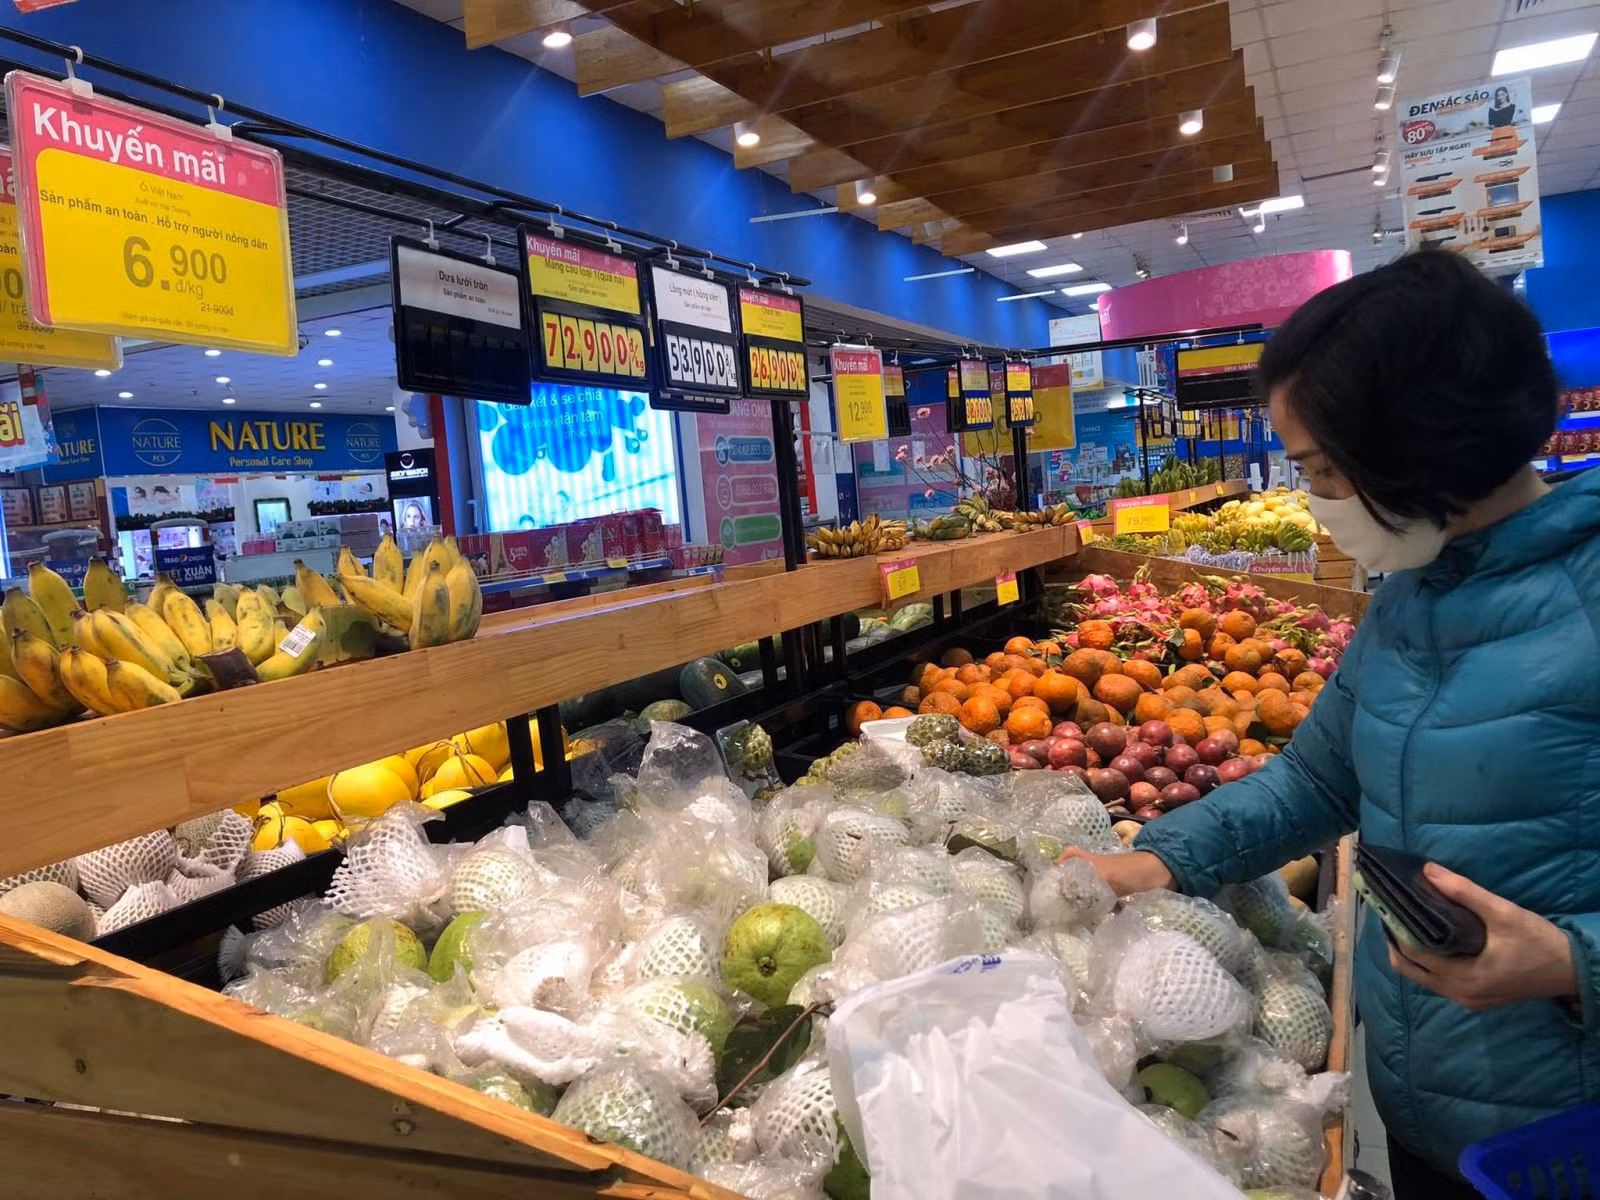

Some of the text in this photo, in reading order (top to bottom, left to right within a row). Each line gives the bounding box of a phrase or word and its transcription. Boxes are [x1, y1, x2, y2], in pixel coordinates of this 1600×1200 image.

[33, 102, 226, 185] Khuyến mãi
[40, 189, 65, 205] Sản
[68, 198, 102, 214] phẩm
[105, 207, 120, 217] an
[122, 208, 148, 223] toàn
[156, 214, 171, 229] Hỗ
[173, 220, 189, 233] trợ
[192, 226, 223, 240] người
[225, 232, 249, 249] nông
[250, 238, 268, 250] dân
[526, 237, 580, 262] Khuyến mãi
[123, 235, 227, 291] 6.900
[175, 278, 204, 300] đ/kg
[438, 270, 489, 291] Dưa lưới tròn
[546, 322, 627, 365] 72.900
[670, 342, 725, 377] 53.900
[751, 351, 797, 381] 26.900
[56, 438, 96, 458] ATURE
[132, 437, 182, 449] NATURE
[208, 419, 326, 452] NATURE
[346, 436, 381, 448] NATURE
[229, 455, 313, 467] Personal Care Shop
[184, 564, 213, 577] XUÂN
